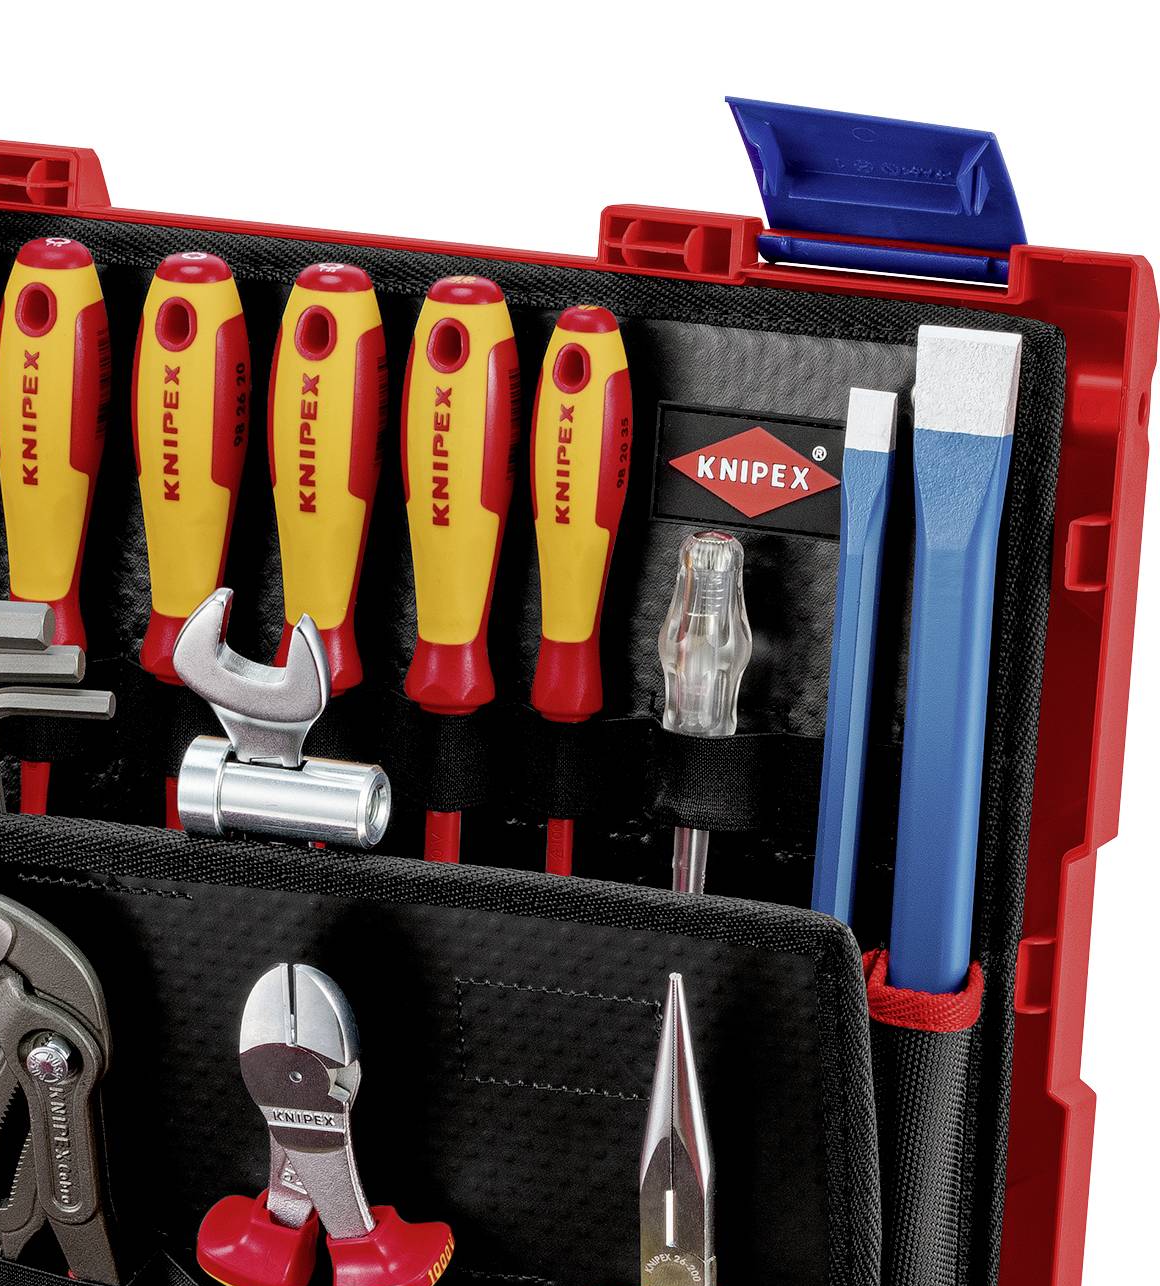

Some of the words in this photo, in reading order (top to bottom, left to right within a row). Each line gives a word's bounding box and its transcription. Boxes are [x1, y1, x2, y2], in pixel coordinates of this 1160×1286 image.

[22, 350, 40, 486] KNIPEX
[163, 365, 180, 502] KNIPEX
[299, 374, 320, 514] KNIPEX
[619, 443, 628, 463] 20
[621, 418, 629, 438] 35
[432, 386, 452, 527] KNIPEX
[555, 404, 576, 525] KNIPEX
[697, 453, 811, 492] KNIPEX
[49, 1086, 70, 1160] KNIPEX
[273, 1110, 335, 1126] KNIPEX
[644, 1253, 671, 1274] KNIPEX
[674, 1255, 702, 1283] 26-200
